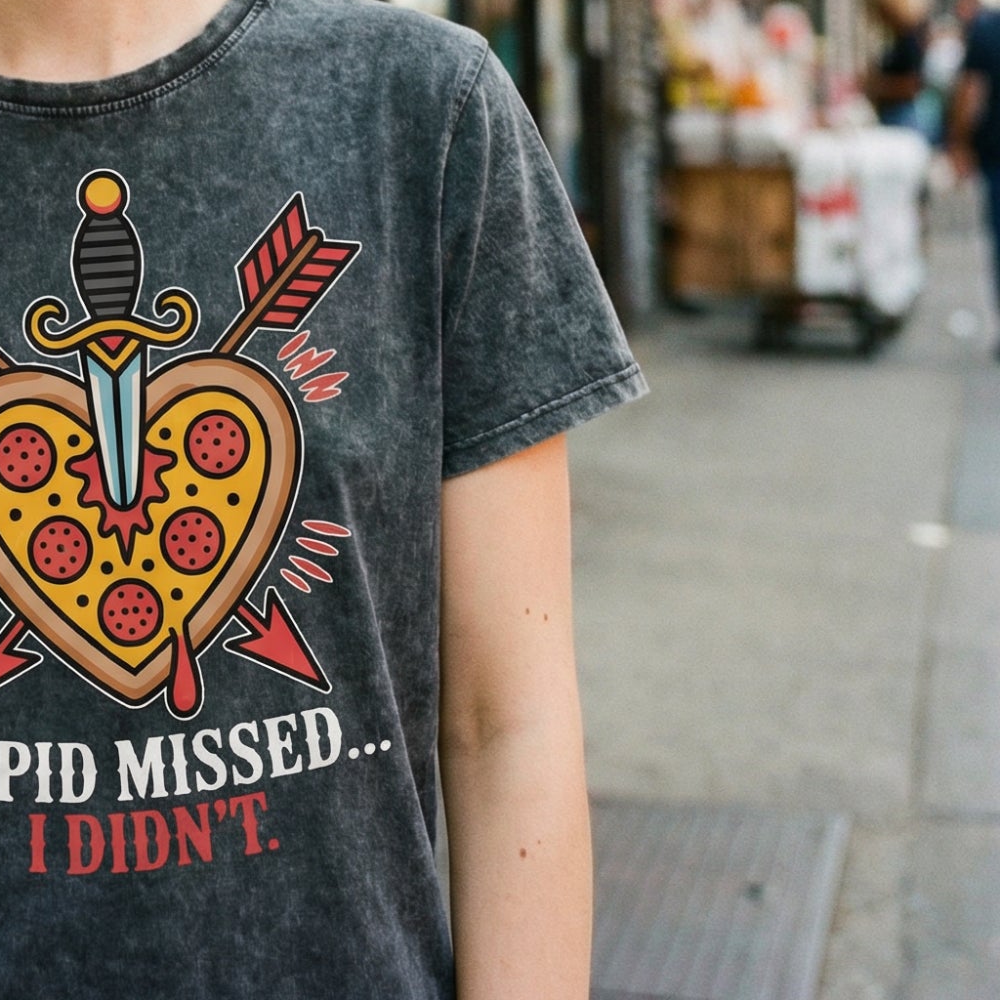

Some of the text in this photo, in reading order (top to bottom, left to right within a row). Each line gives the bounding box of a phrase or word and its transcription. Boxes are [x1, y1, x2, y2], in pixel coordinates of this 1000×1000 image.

[114, 706, 392, 801] MISSED...
[29, 791, 280, 875] I DIDN'T.
